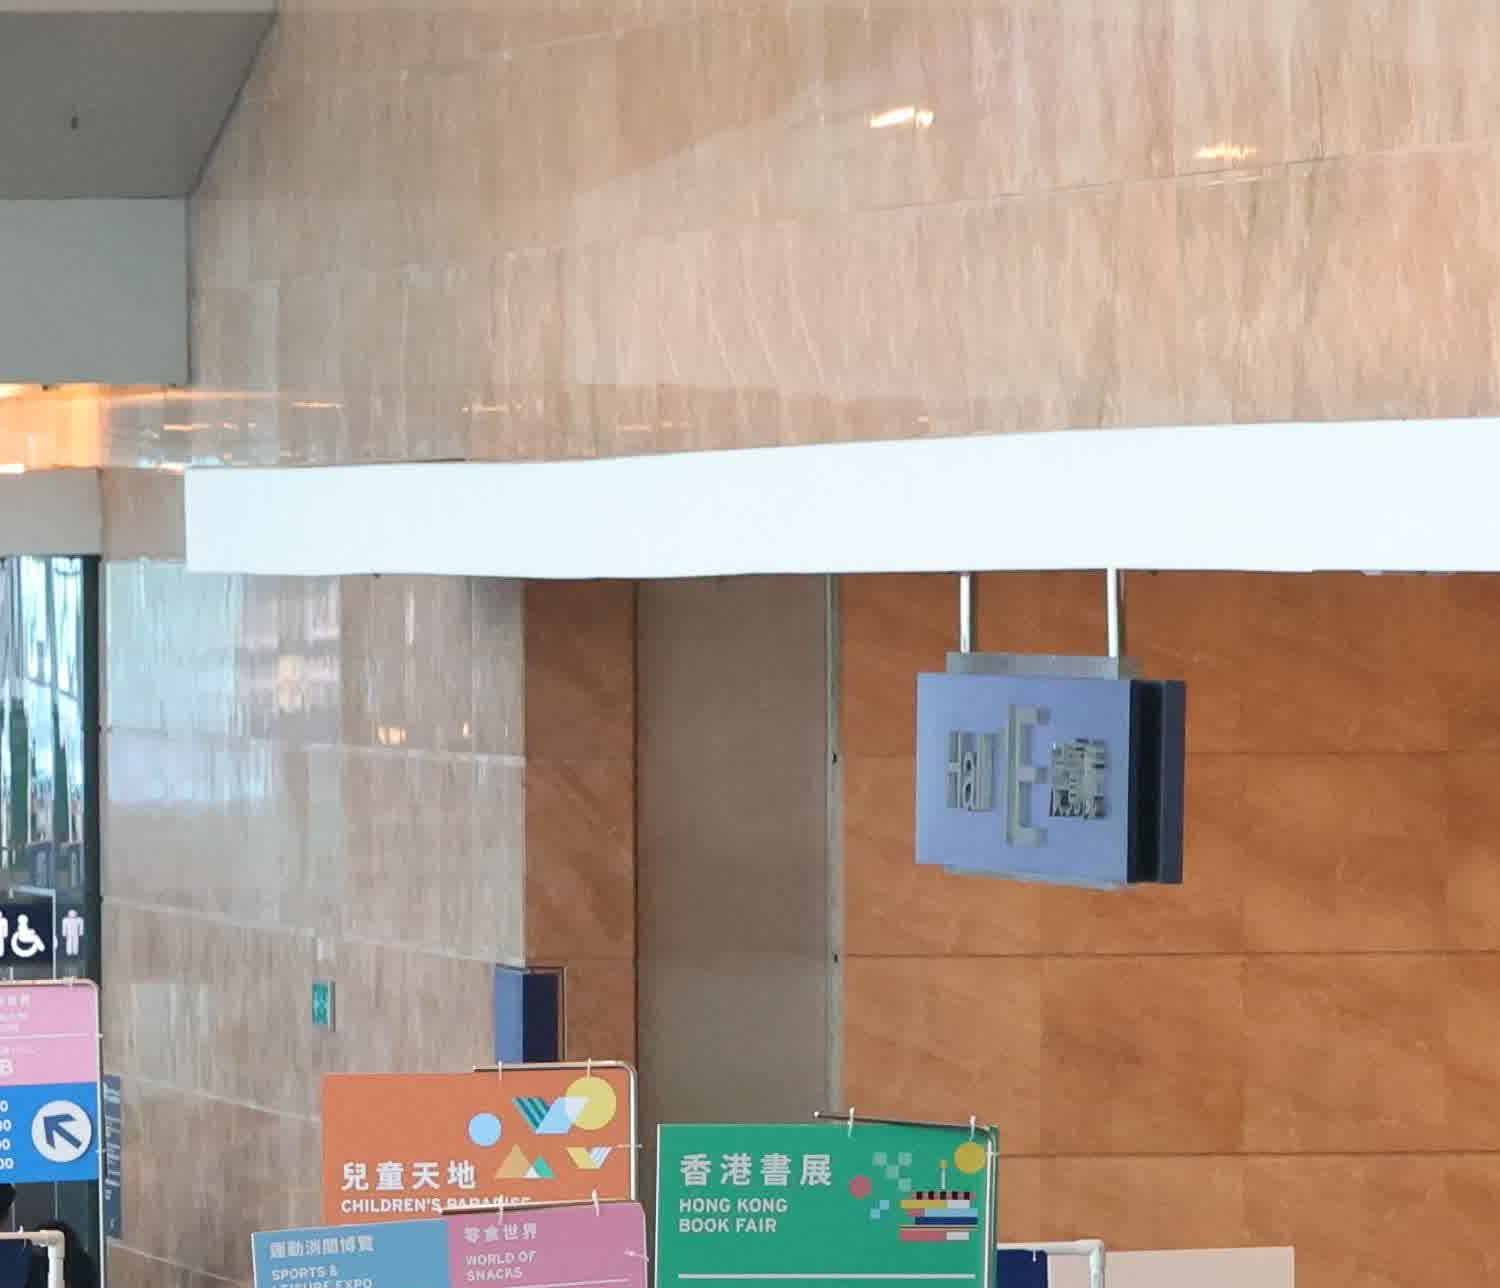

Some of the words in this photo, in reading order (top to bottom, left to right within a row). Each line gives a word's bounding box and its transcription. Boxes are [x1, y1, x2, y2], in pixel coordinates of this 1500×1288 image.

[341, 1160, 477, 1191] 兒童天地
[679, 1153, 833, 1187] 香港書展
[341, 1197, 442, 1214] CHILDREN'S
[679, 1197, 731, 1213] HONG
[736, 1197, 788, 1213] KONG
[679, 1217, 730, 1233] BOOK
[735, 1217, 777, 1232] FAIR
[463, 1223, 537, 1245] 零食世界
[465, 1252, 515, 1267] WORLD
[518, 1250, 537, 1265] OF
[271, 1265, 326, 1282] SPORTS
[329, 1264, 338, 1278] &
[466, 1266, 524, 1282] SNACKS
